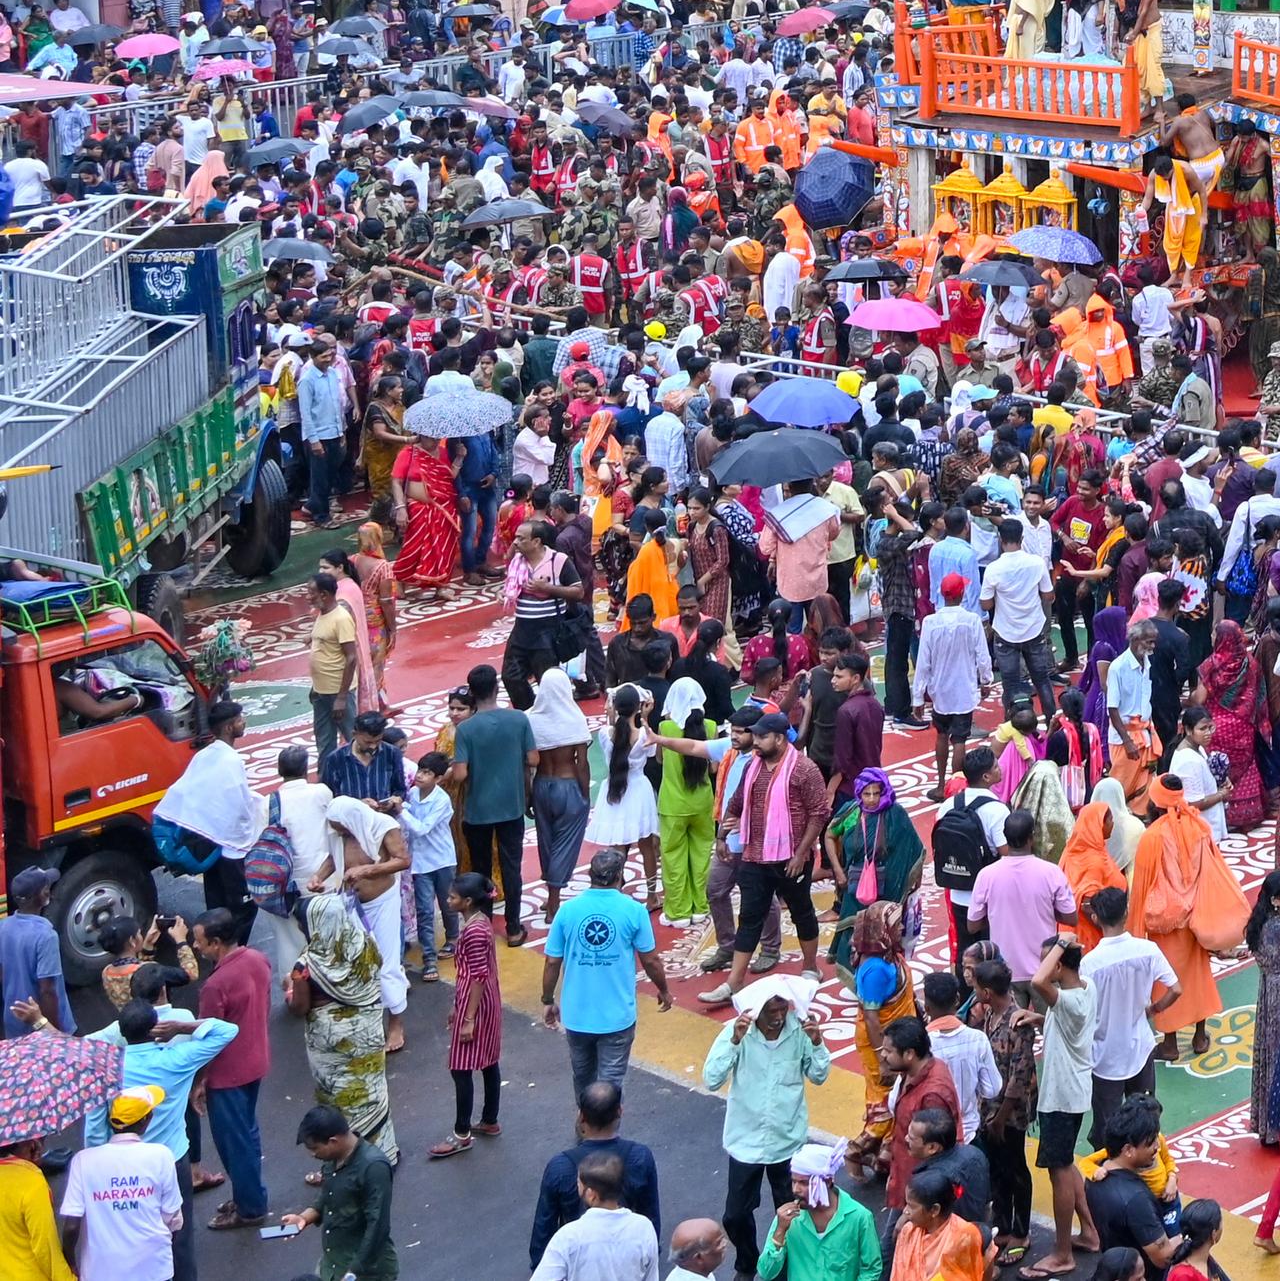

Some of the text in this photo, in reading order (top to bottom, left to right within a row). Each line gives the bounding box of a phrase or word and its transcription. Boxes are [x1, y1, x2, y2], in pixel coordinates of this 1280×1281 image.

[115, 773, 148, 791] EICHER
[248, 884, 276, 895] NIKE
[110, 1175, 139, 1188] RAM
[92, 1186, 154, 1202] NARAYAN
[112, 1200, 139, 1211] RAM
